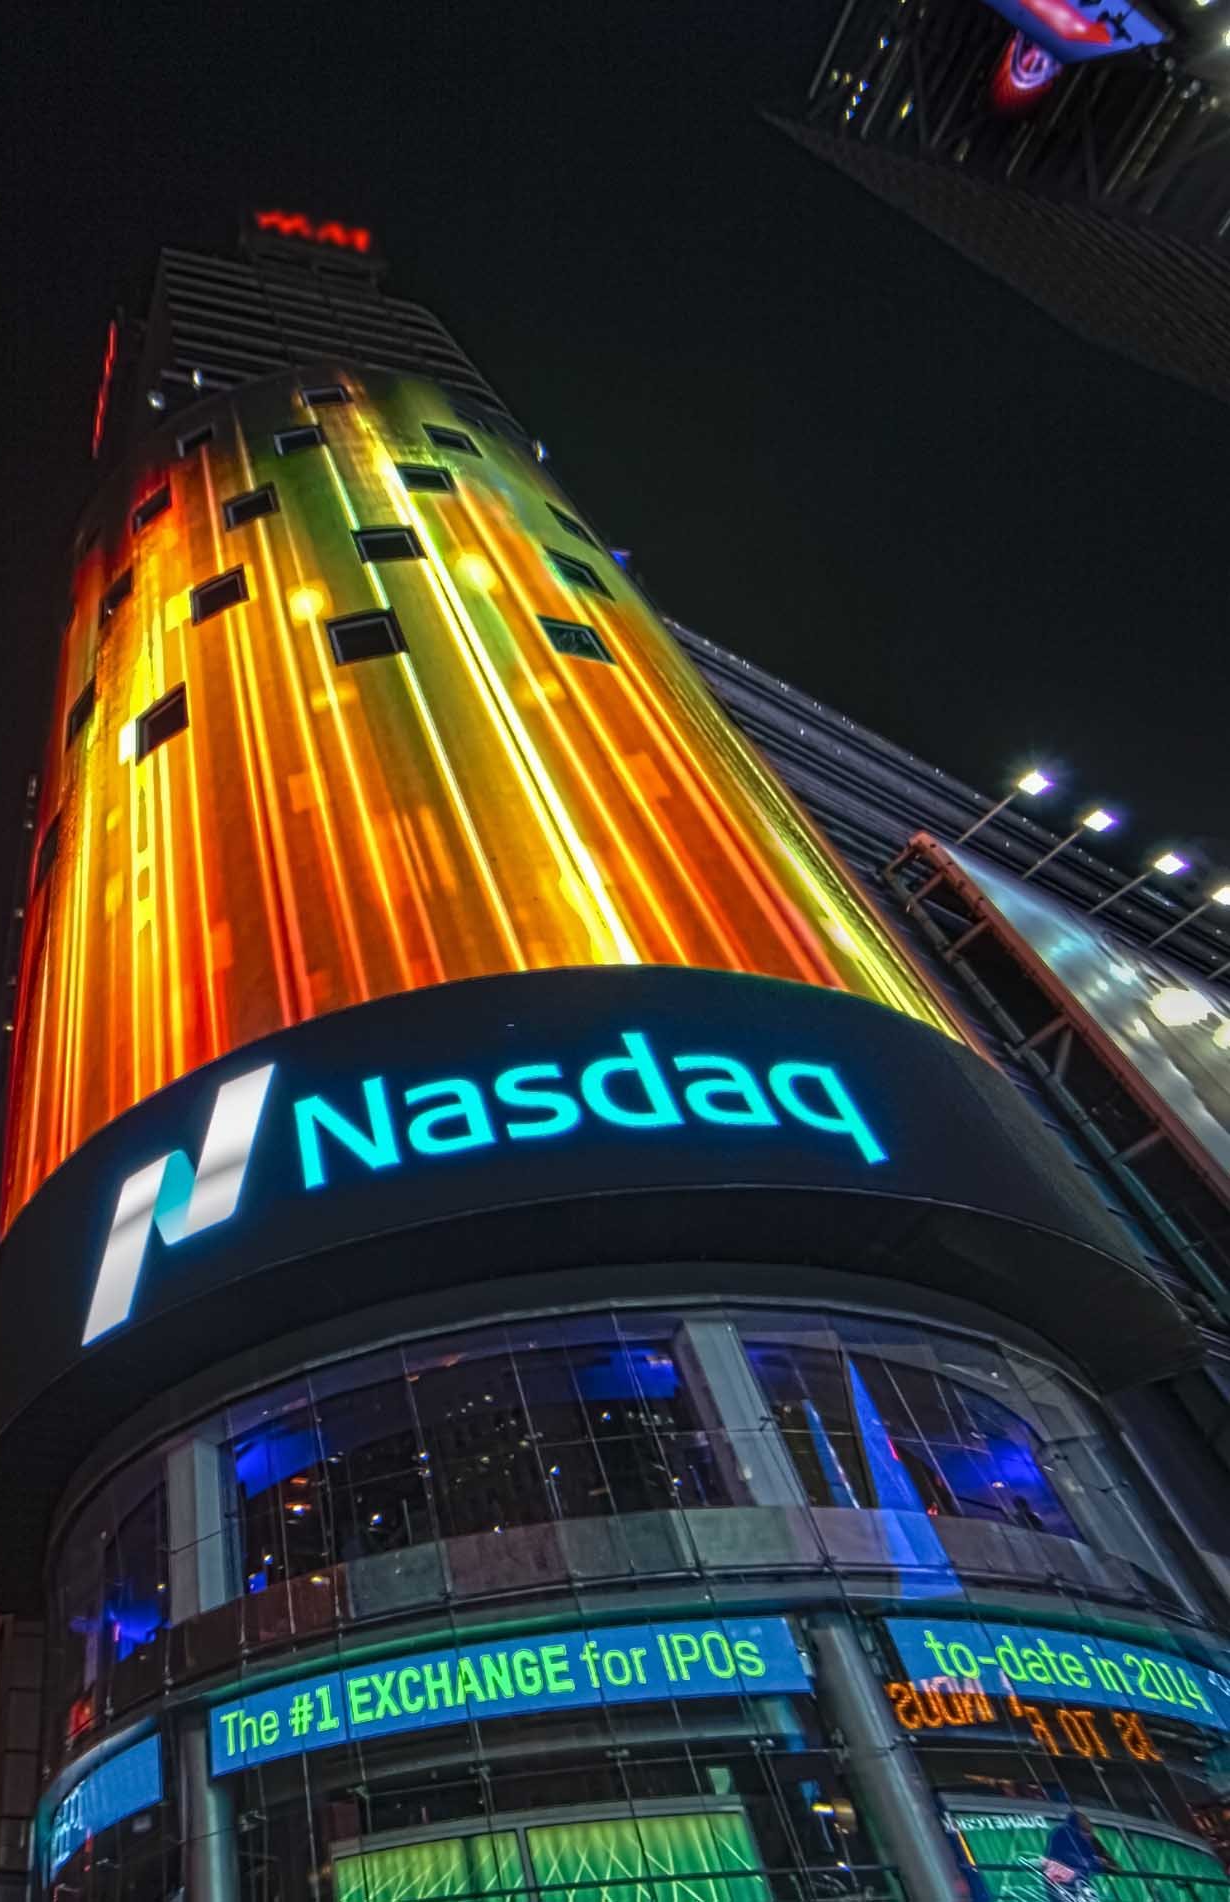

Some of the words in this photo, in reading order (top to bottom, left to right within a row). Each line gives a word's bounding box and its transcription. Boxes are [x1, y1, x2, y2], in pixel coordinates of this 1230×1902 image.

[294, 1031, 889, 1190] Nasdaq
[219, 1710, 279, 1757] The
[288, 1691, 340, 1736] #1
[348, 1643, 575, 1725] EXCHANGE
[580, 1640, 647, 1689] for
[656, 1630, 767, 1682] IPOs
[923, 1630, 1092, 1688] to-date
[1081, 1643, 1136, 1695] in
[1123, 1652, 1213, 1714] 2014
